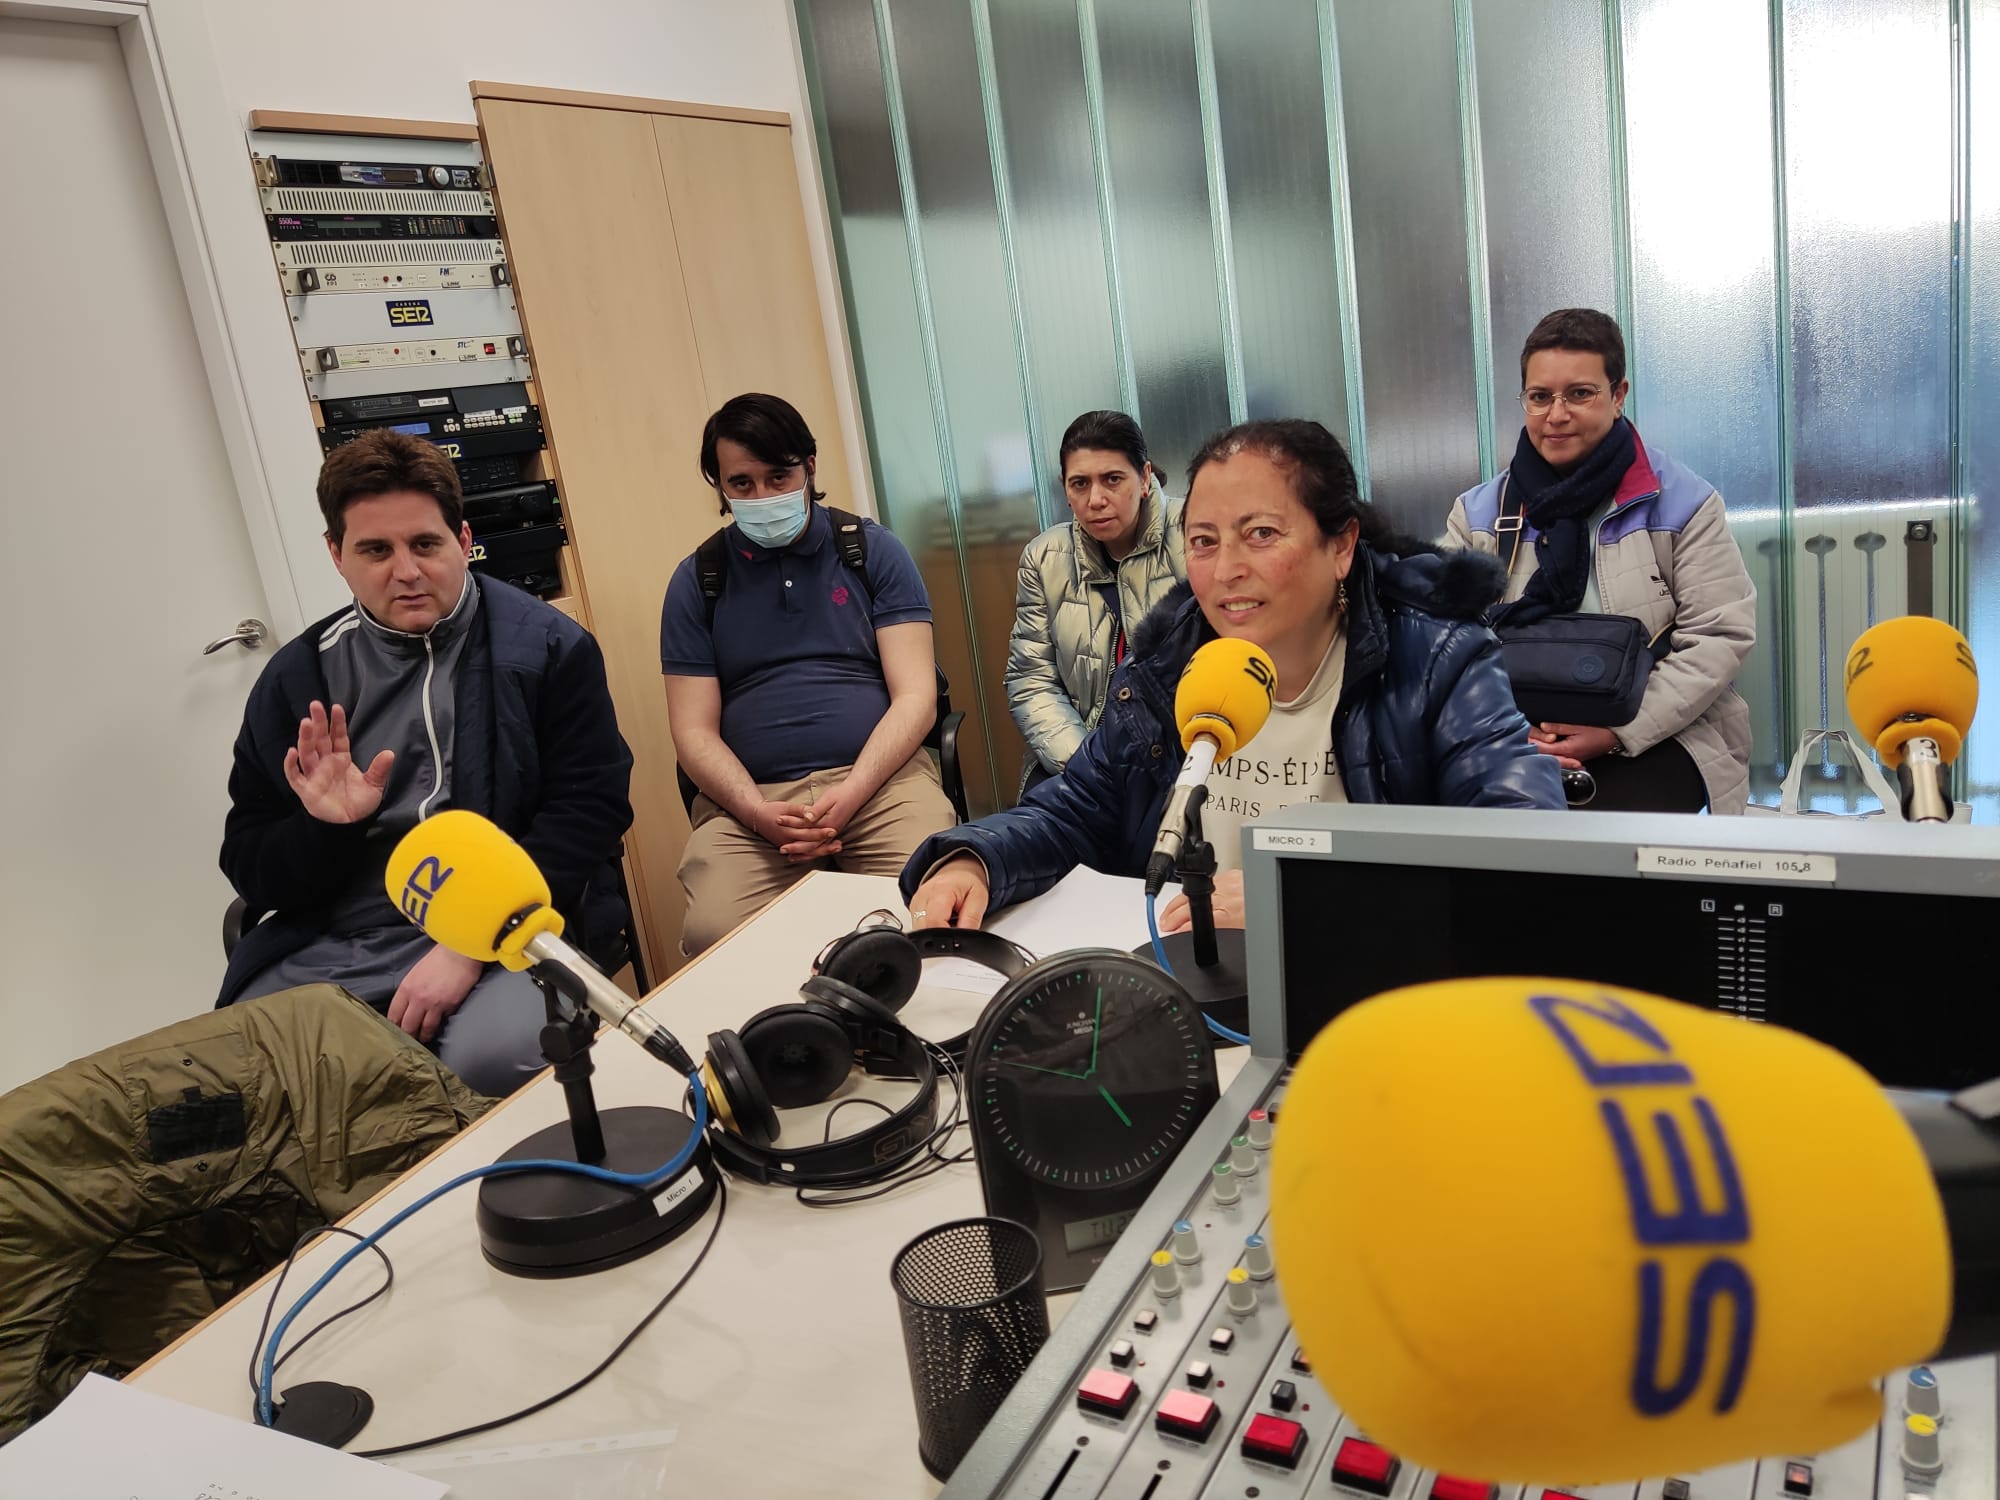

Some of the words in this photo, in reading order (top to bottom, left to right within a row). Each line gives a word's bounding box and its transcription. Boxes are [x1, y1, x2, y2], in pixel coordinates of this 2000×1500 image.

[390, 307, 431, 324] SER
[1205, 793, 1262, 818] PARIS
[1268, 835, 1304, 846] MICRO
[1309, 837, 1317, 846] 2
[1657, 855, 1697, 868] Radio
[1704, 858, 1762, 871] Peñafiel
[666, 1186, 687, 1202] Micro
[1526, 991, 1758, 1417] SER
